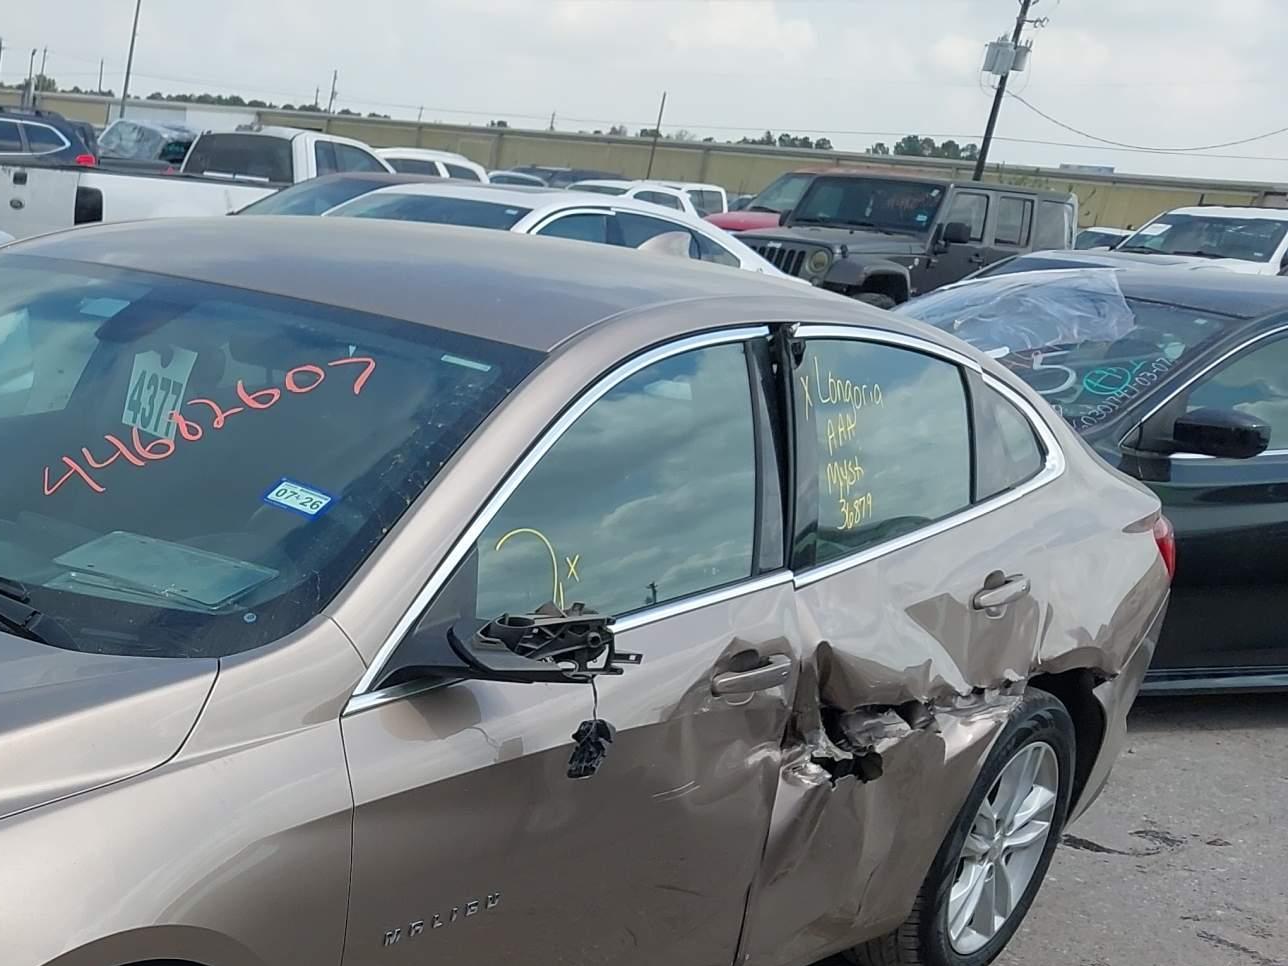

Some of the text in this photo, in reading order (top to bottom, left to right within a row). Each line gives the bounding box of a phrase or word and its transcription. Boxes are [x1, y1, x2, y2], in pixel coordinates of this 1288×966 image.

[44, 356, 376, 495] 44682607
[127, 368, 185, 438] 4377
[275, 488, 323, 510] 07 26
[383, 892, 500, 947] MALIBU
